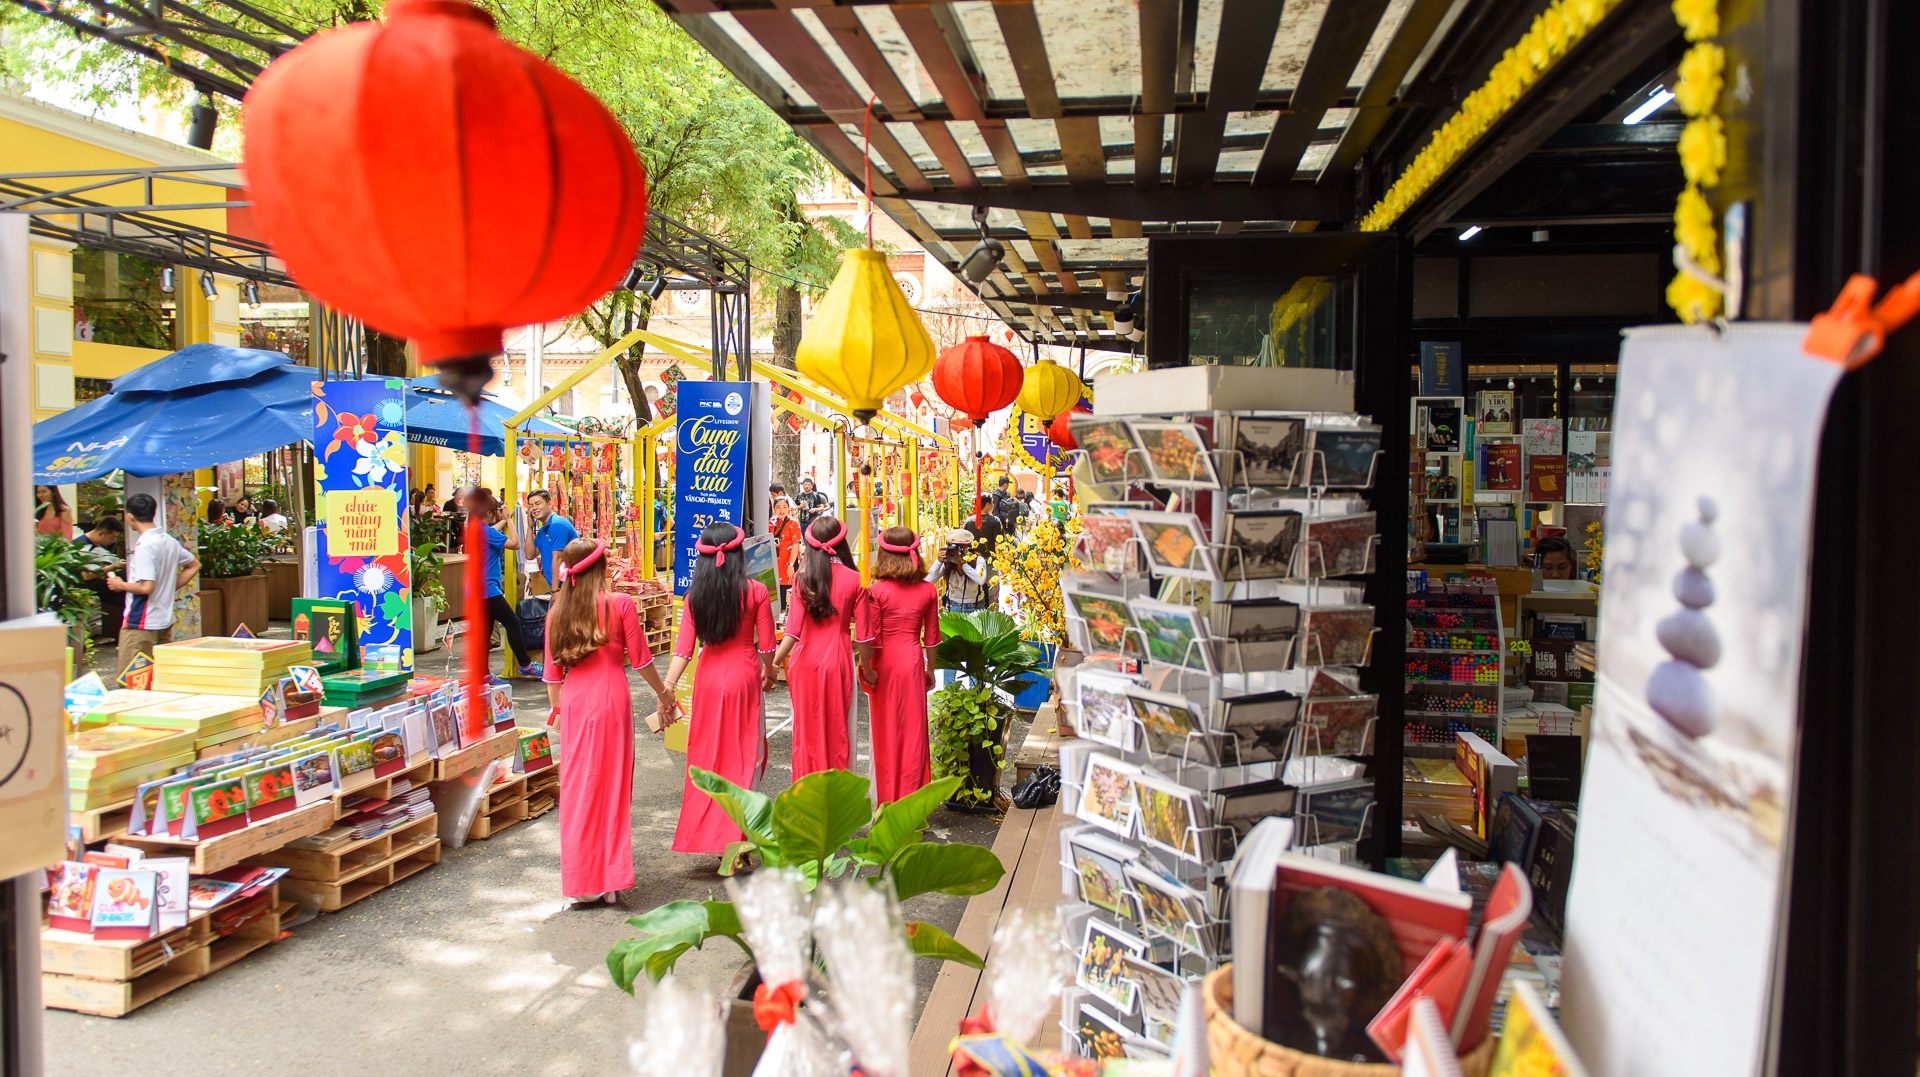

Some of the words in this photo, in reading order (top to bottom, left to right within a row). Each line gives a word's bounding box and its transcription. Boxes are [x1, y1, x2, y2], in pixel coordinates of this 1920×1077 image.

[422, 435, 448, 446] MINH
[679, 414, 741, 459] Cung
[690, 474, 732, 492] xưa
[345, 495, 378, 512] chúc
[1550, 624, 1558, 635] 7
